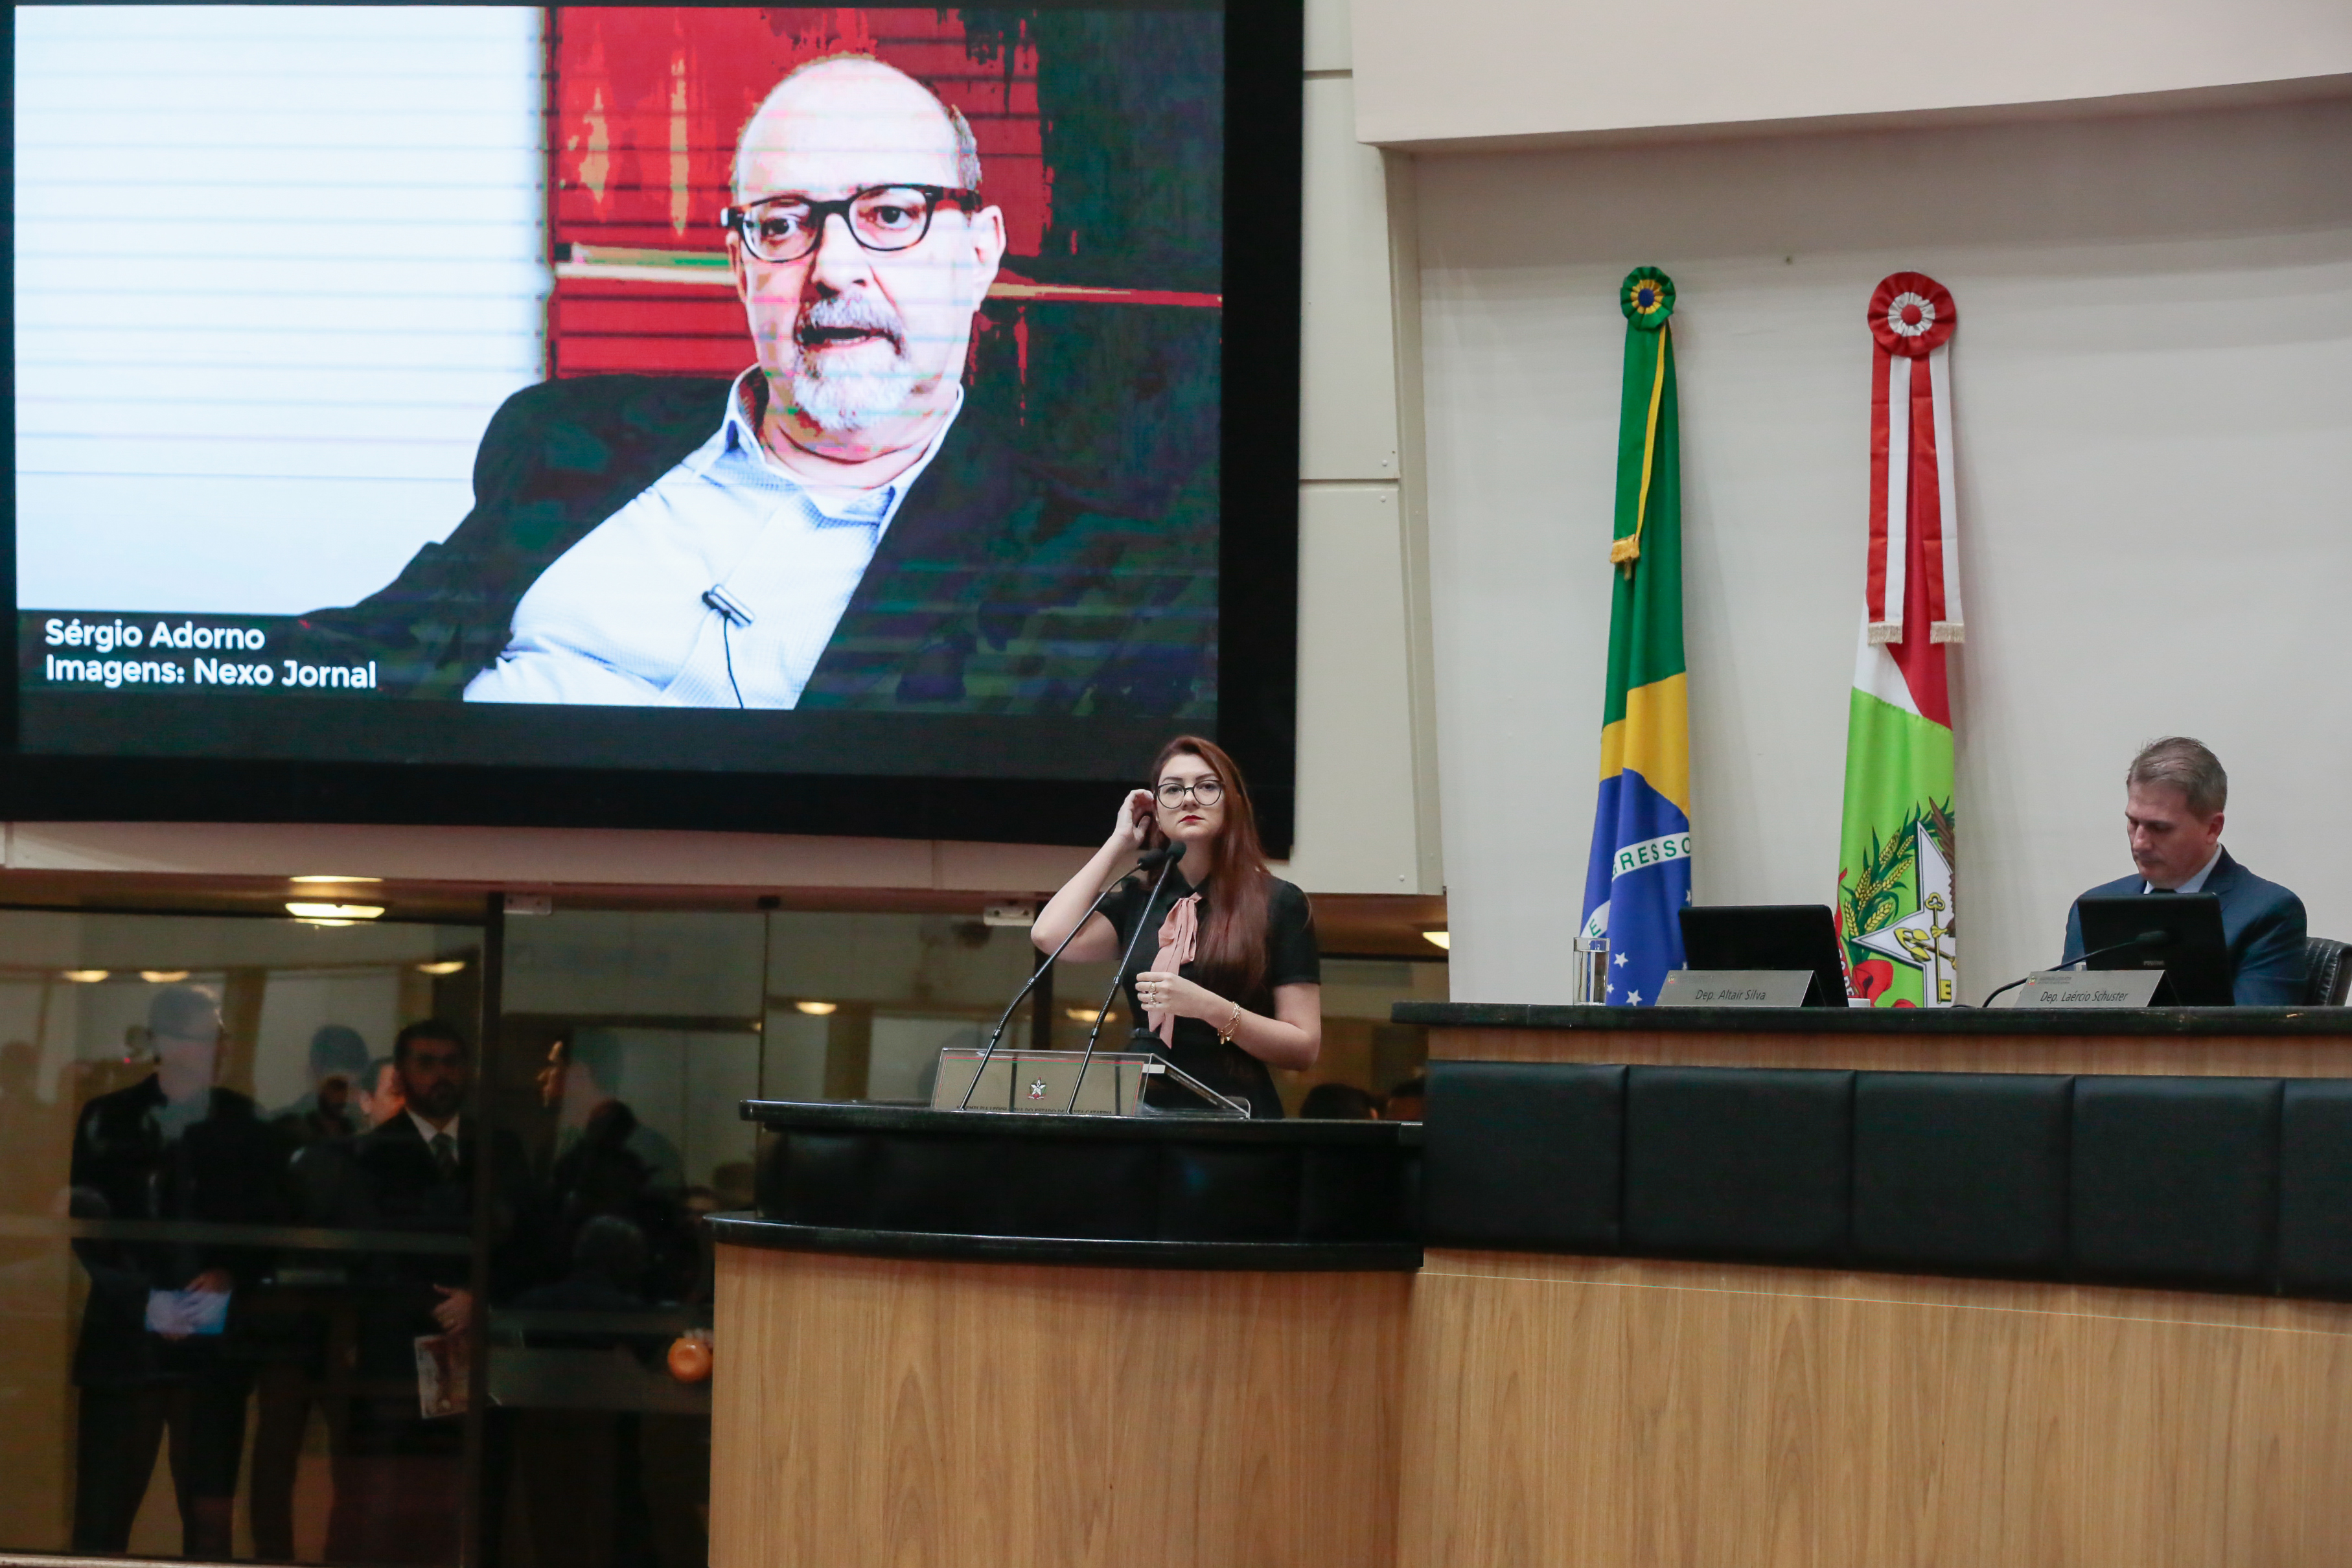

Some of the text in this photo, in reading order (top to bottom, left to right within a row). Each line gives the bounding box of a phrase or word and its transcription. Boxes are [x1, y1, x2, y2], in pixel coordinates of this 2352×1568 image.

[45, 617, 266, 652] Sérgio Adorno
[46, 653, 376, 689] Imagens: Nexo Jornal
[1695, 989, 1766, 1002] Dep. Altair Silva
[2040, 990, 2128, 1004] Dep. Laércio Schuster
